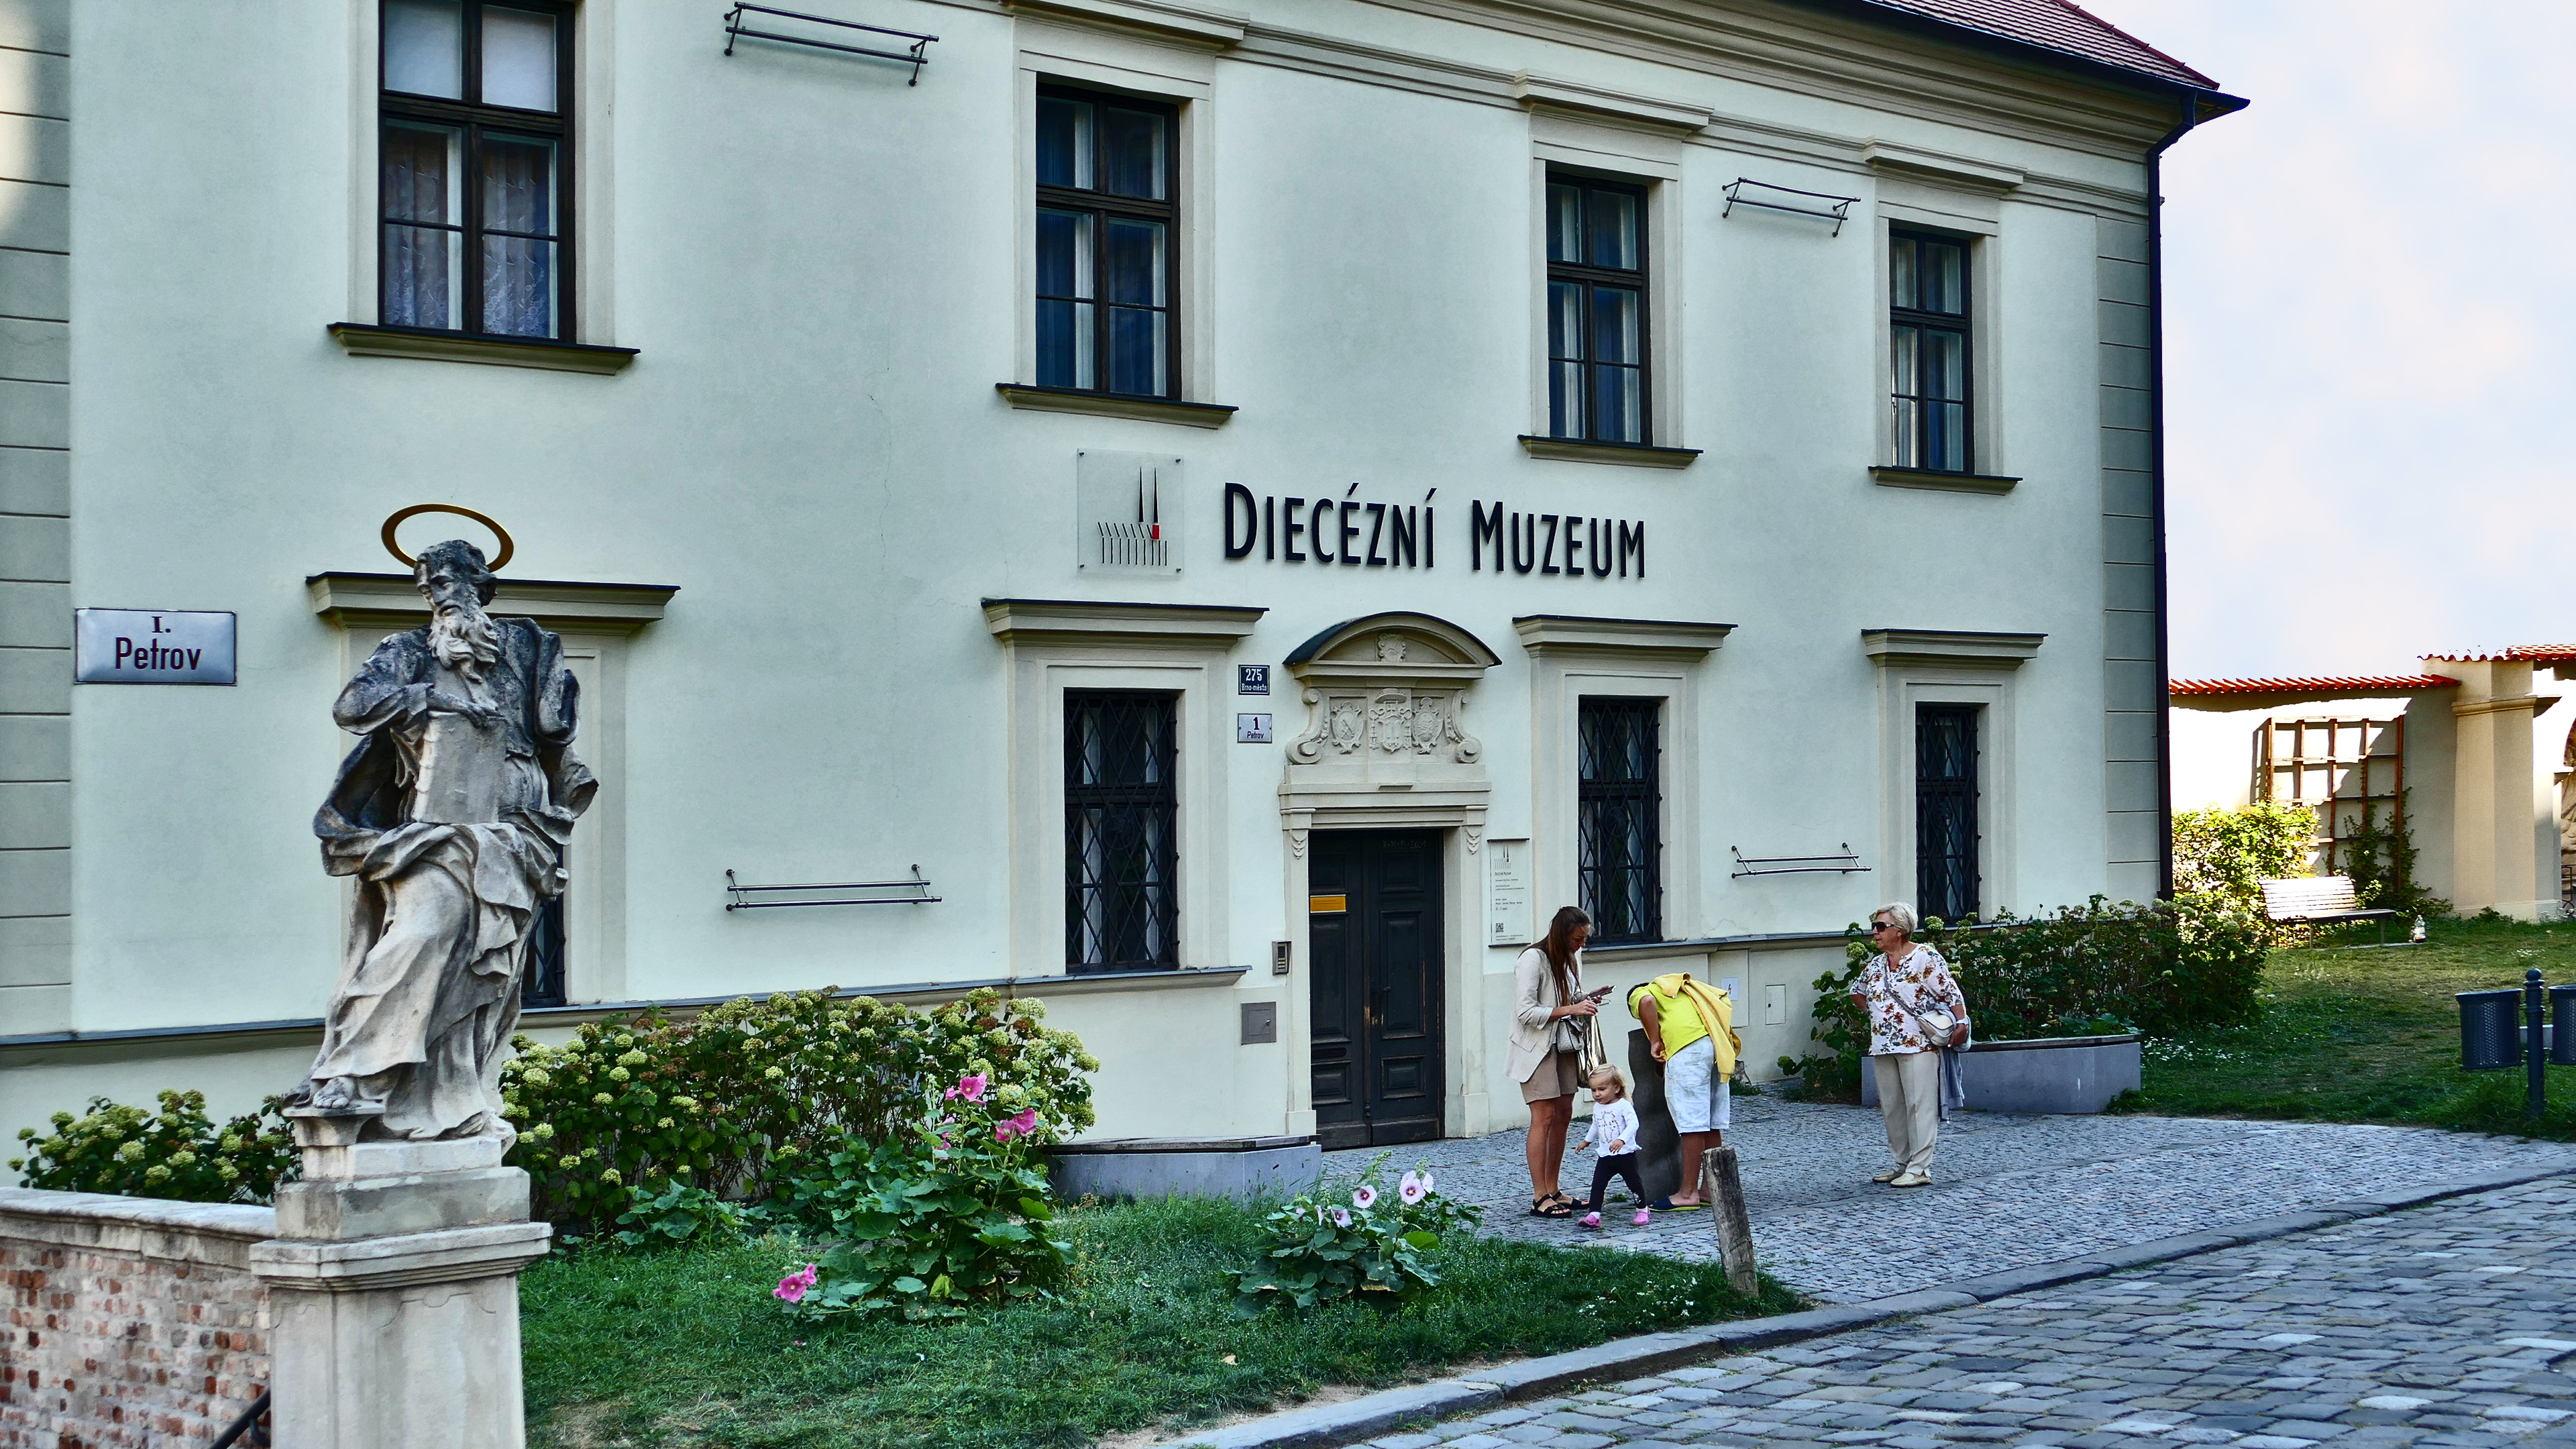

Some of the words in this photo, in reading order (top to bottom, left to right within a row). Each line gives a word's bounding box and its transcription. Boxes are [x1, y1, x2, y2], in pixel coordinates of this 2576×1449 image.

[1225, 482, 1437, 569] DIECÉZNÍ
[1472, 499, 1646, 578] MUZEUM
[115, 637, 201, 670] Petrov
[1246, 668, 1262, 681] 275
[1253, 716, 1260, 730] 1
[1246, 731, 1265, 739] Petrov
